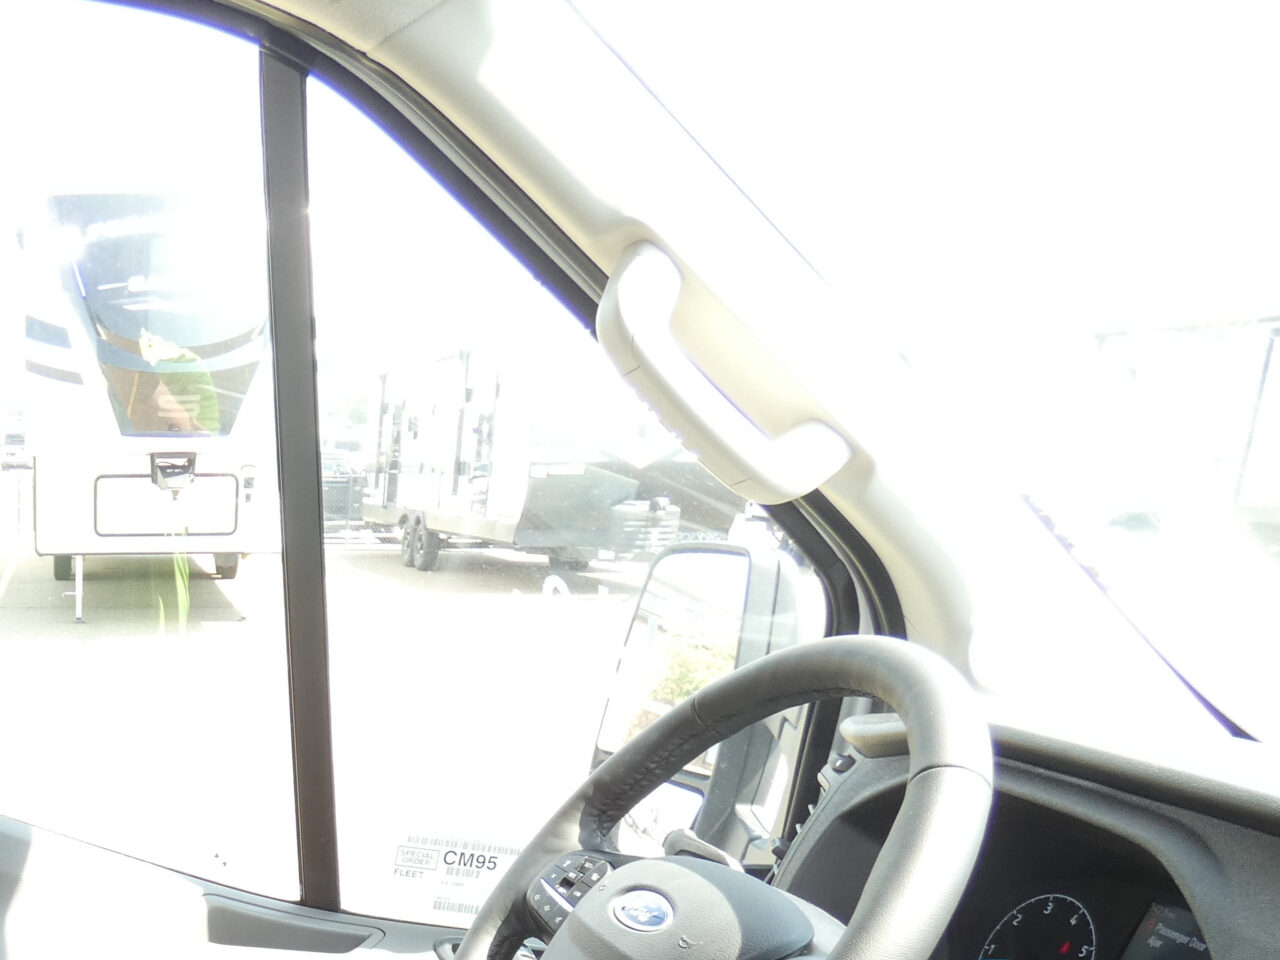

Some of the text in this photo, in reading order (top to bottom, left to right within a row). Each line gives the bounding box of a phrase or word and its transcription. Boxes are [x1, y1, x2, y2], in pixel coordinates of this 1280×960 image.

[400, 848, 434, 860] SPECIAL
[401, 857, 431, 866] ORDER
[443, 850, 498, 871] CM95
[393, 868, 425, 879] FLEET
[1043, 902, 1053, 914] 3
[1012, 914, 1023, 926] 2
[1069, 915, 1078, 926] 4
[1155, 921, 1190, 944] Passenger
[988, 944, 995, 955] 1
[1078, 946, 1089, 957] 5
